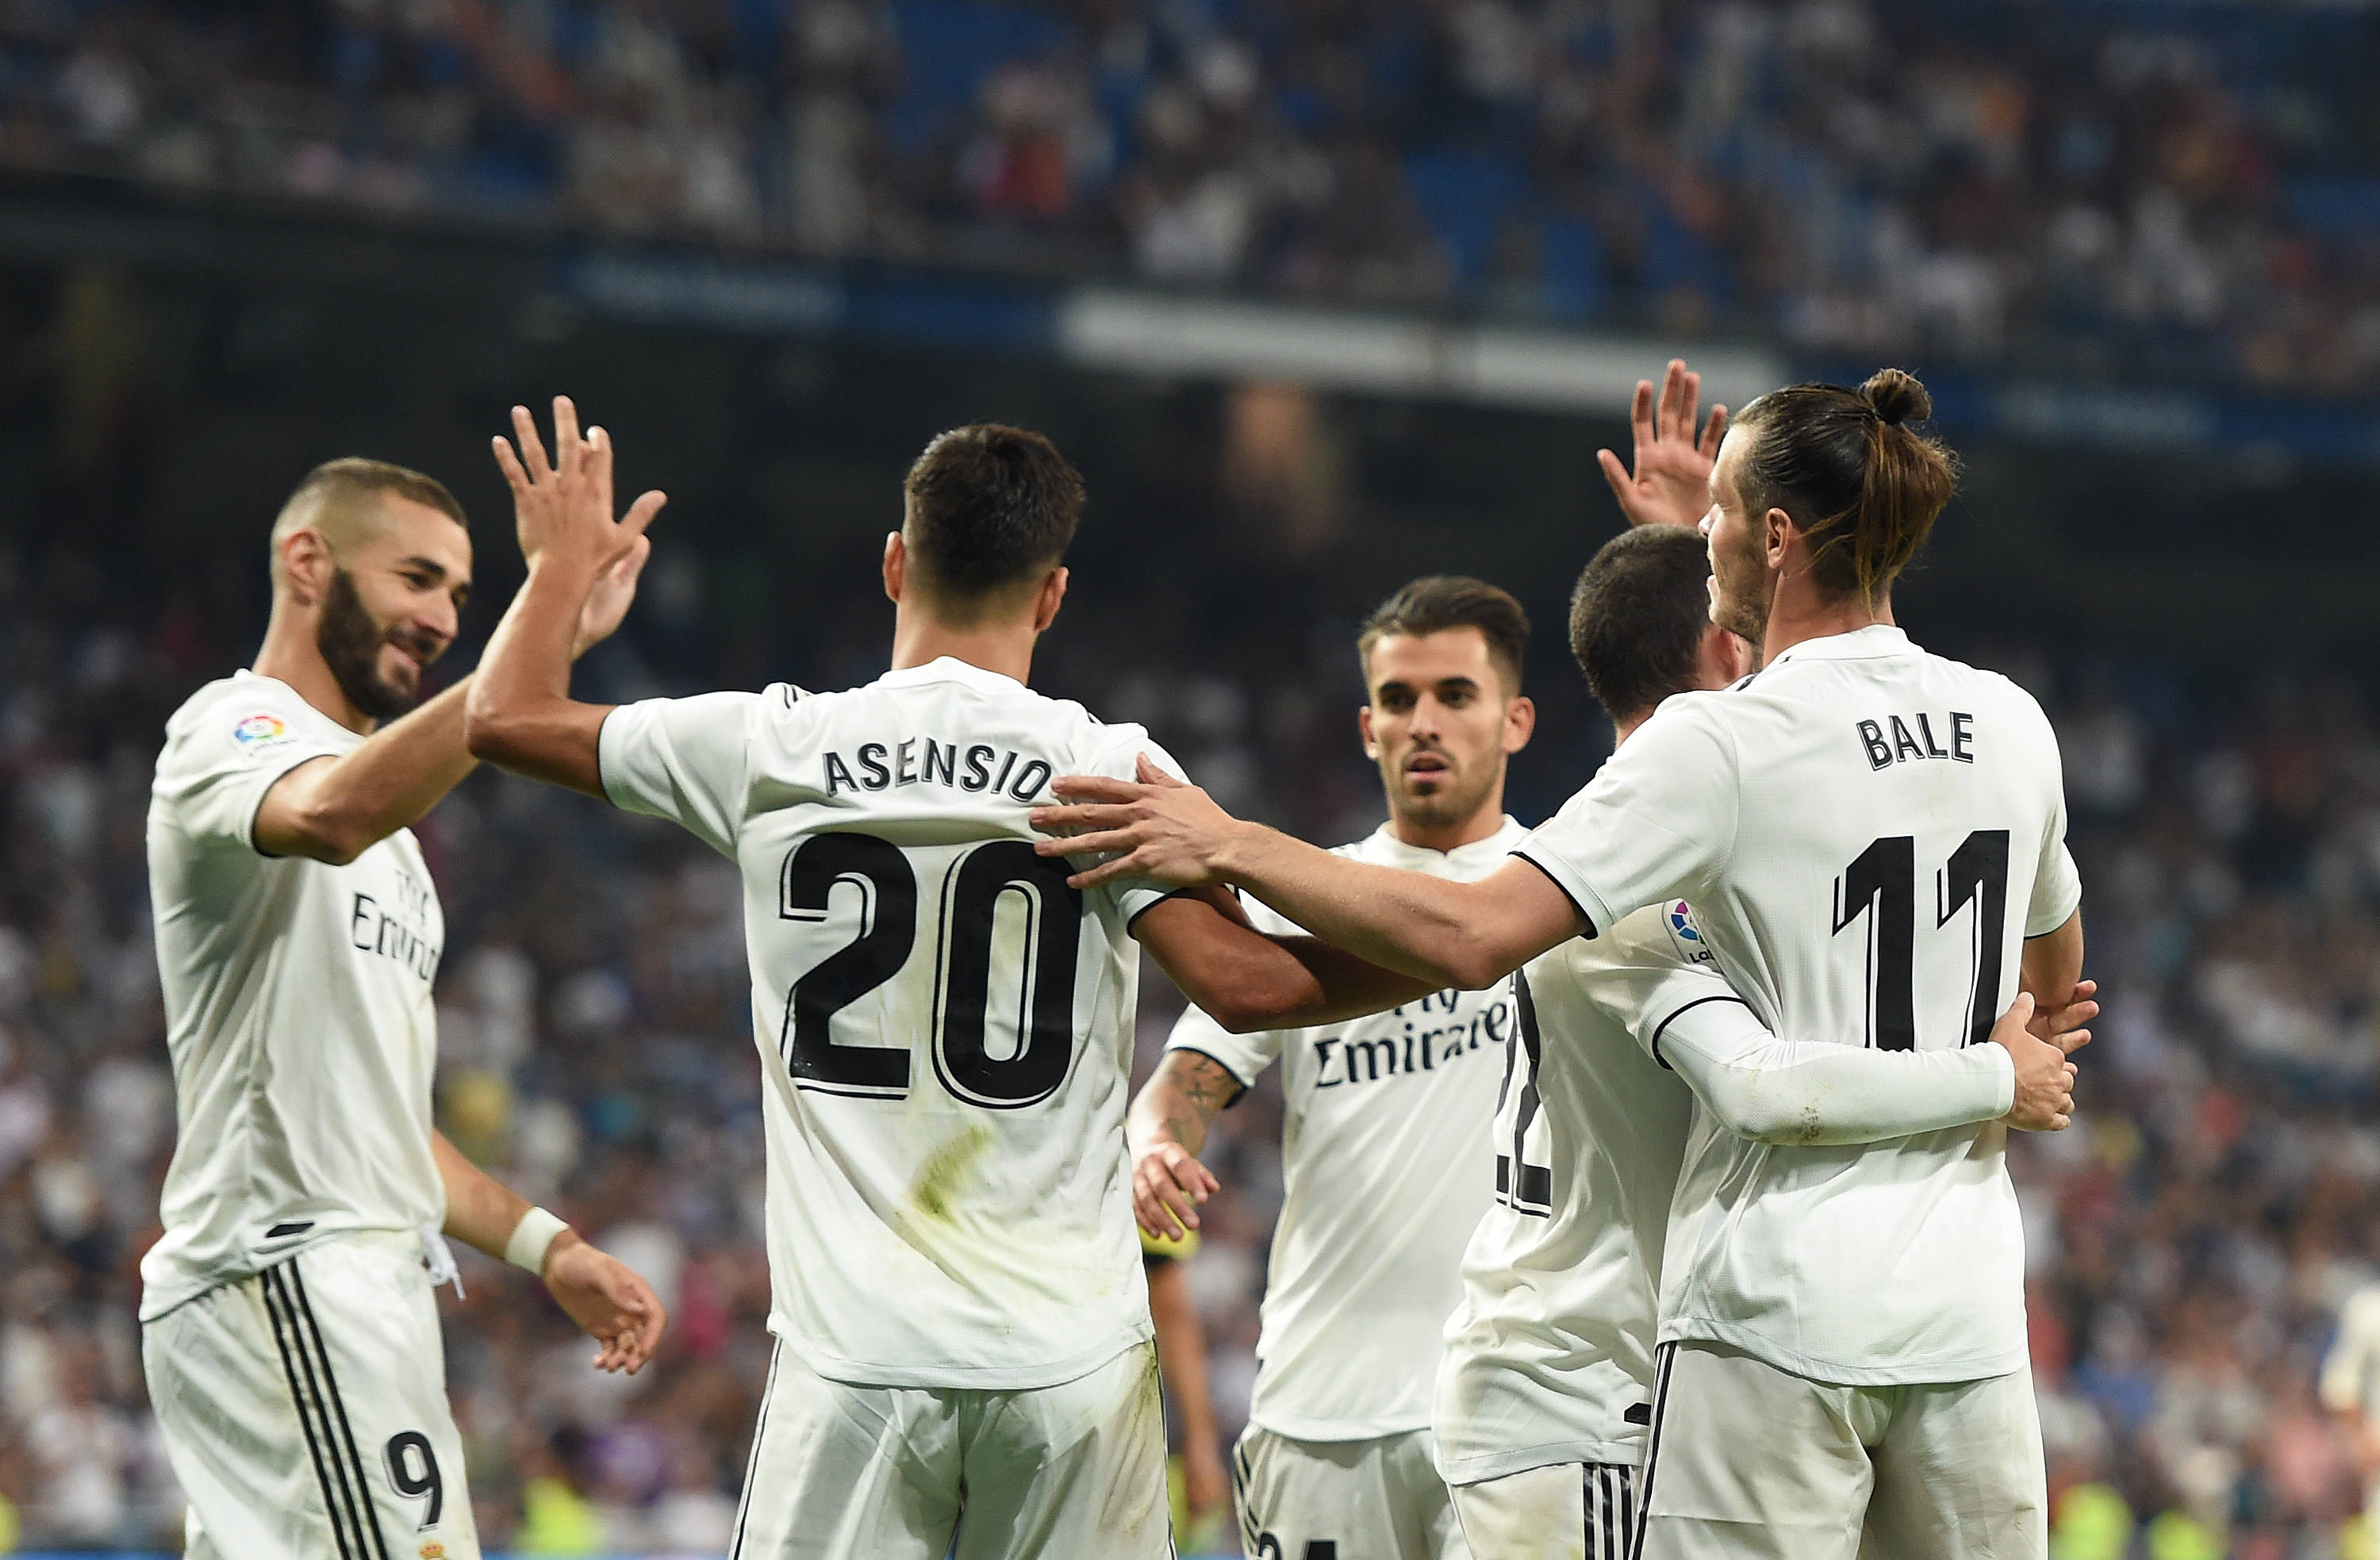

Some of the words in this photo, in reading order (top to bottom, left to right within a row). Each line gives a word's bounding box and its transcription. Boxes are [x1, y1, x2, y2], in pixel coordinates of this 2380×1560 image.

[822, 736, 1052, 803] ASENSIO
[1856, 711, 1974, 771] BALE
[779, 832, 1084, 1110] 20
[1831, 830, 2010, 1053] 11
[1314, 1002, 1507, 1087] Emirate
[382, 1431, 443, 1534] 9
